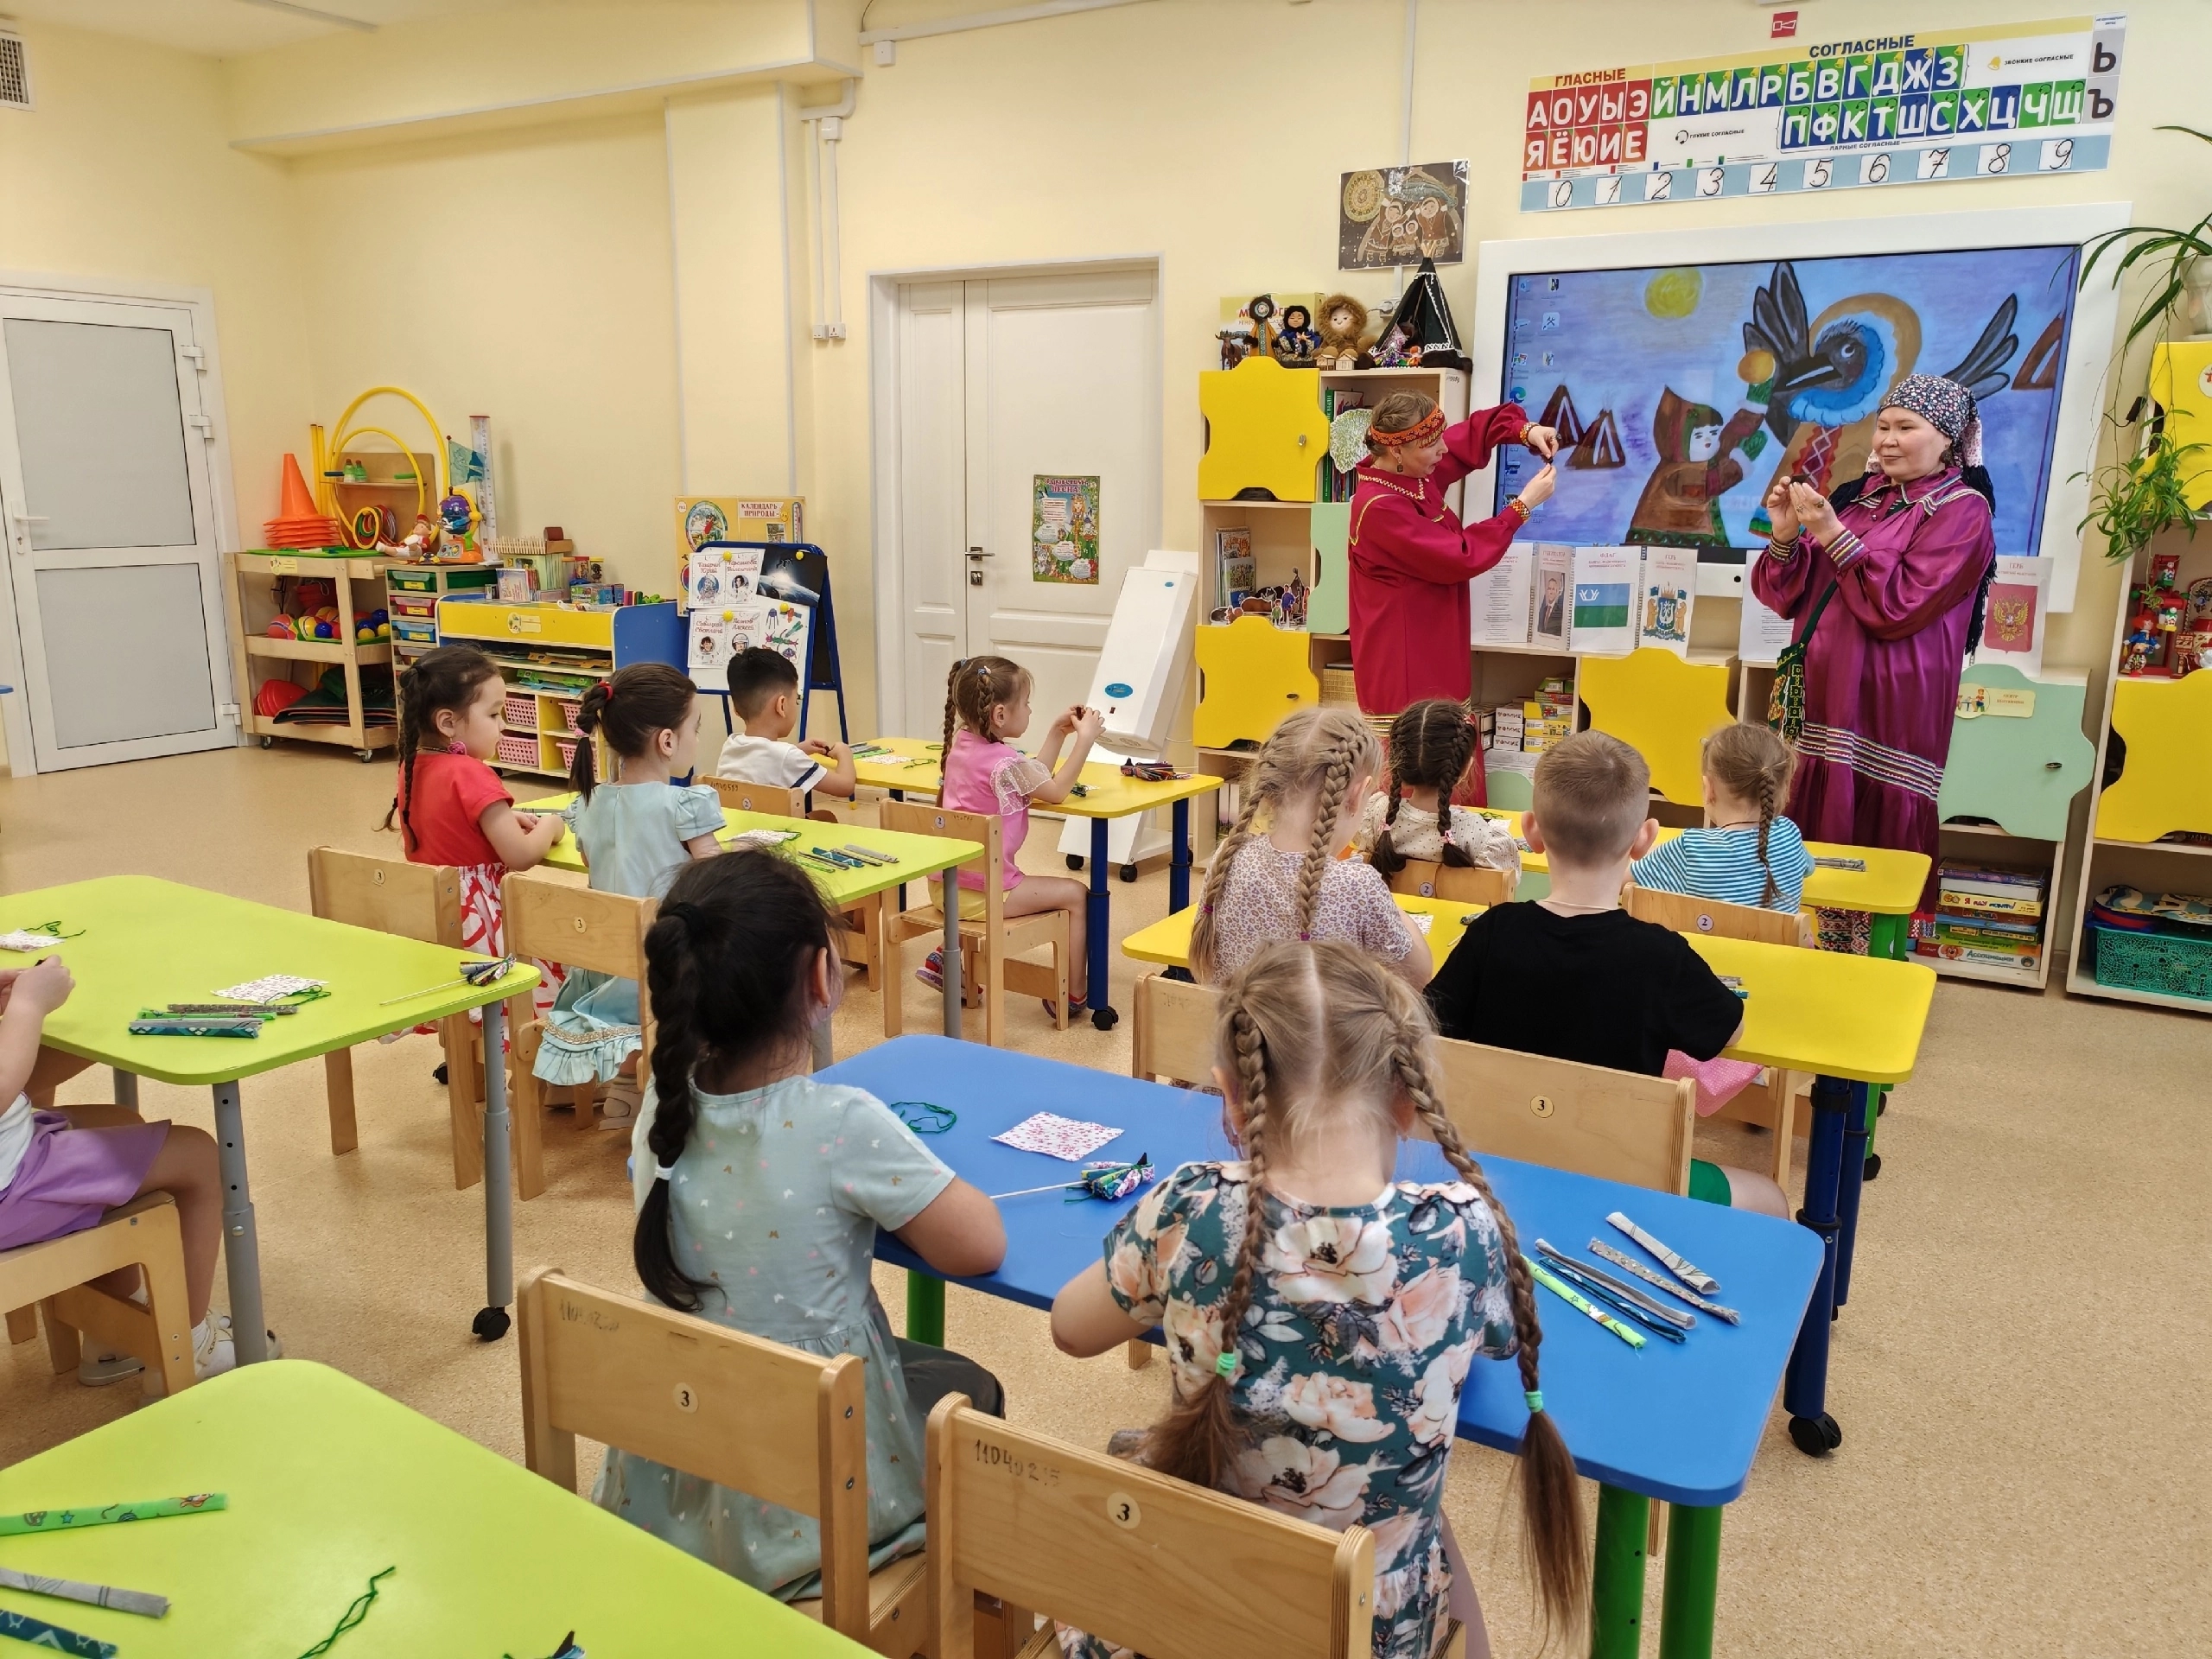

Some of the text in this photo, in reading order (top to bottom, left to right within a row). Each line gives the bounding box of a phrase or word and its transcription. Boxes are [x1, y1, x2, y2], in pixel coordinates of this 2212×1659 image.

[1809, 35, 1915, 59] СОГЛАСНЫЕ
[2034, 54, 2074, 63] СОГЛАСНЫЕ
[2093, 42, 2117, 73] Ь
[1555, 68, 1626, 87] ГЛАСНЫЕ
[2088, 88, 2113, 119] Ъ
[1711, 129, 1745, 137] СОГЛАСНЫЕ
[1859, 140, 1900, 149] СОГЛАСНЫЕ
[1555, 138, 2074, 207] 0 1 2 3 4 5 6 7 8 9
[741, 503, 778, 512] КАЛЕНДАРЬ
[377, 872, 383, 880] 3
[1424, 885, 1430, 893] 2
[578, 919, 583, 929] 3
[1701, 918, 1708, 926] 2
[1537, 1099, 1546, 1110] 3
[680, 1389, 690, 1408] 3
[1116, 1503, 1130, 1522] 3
